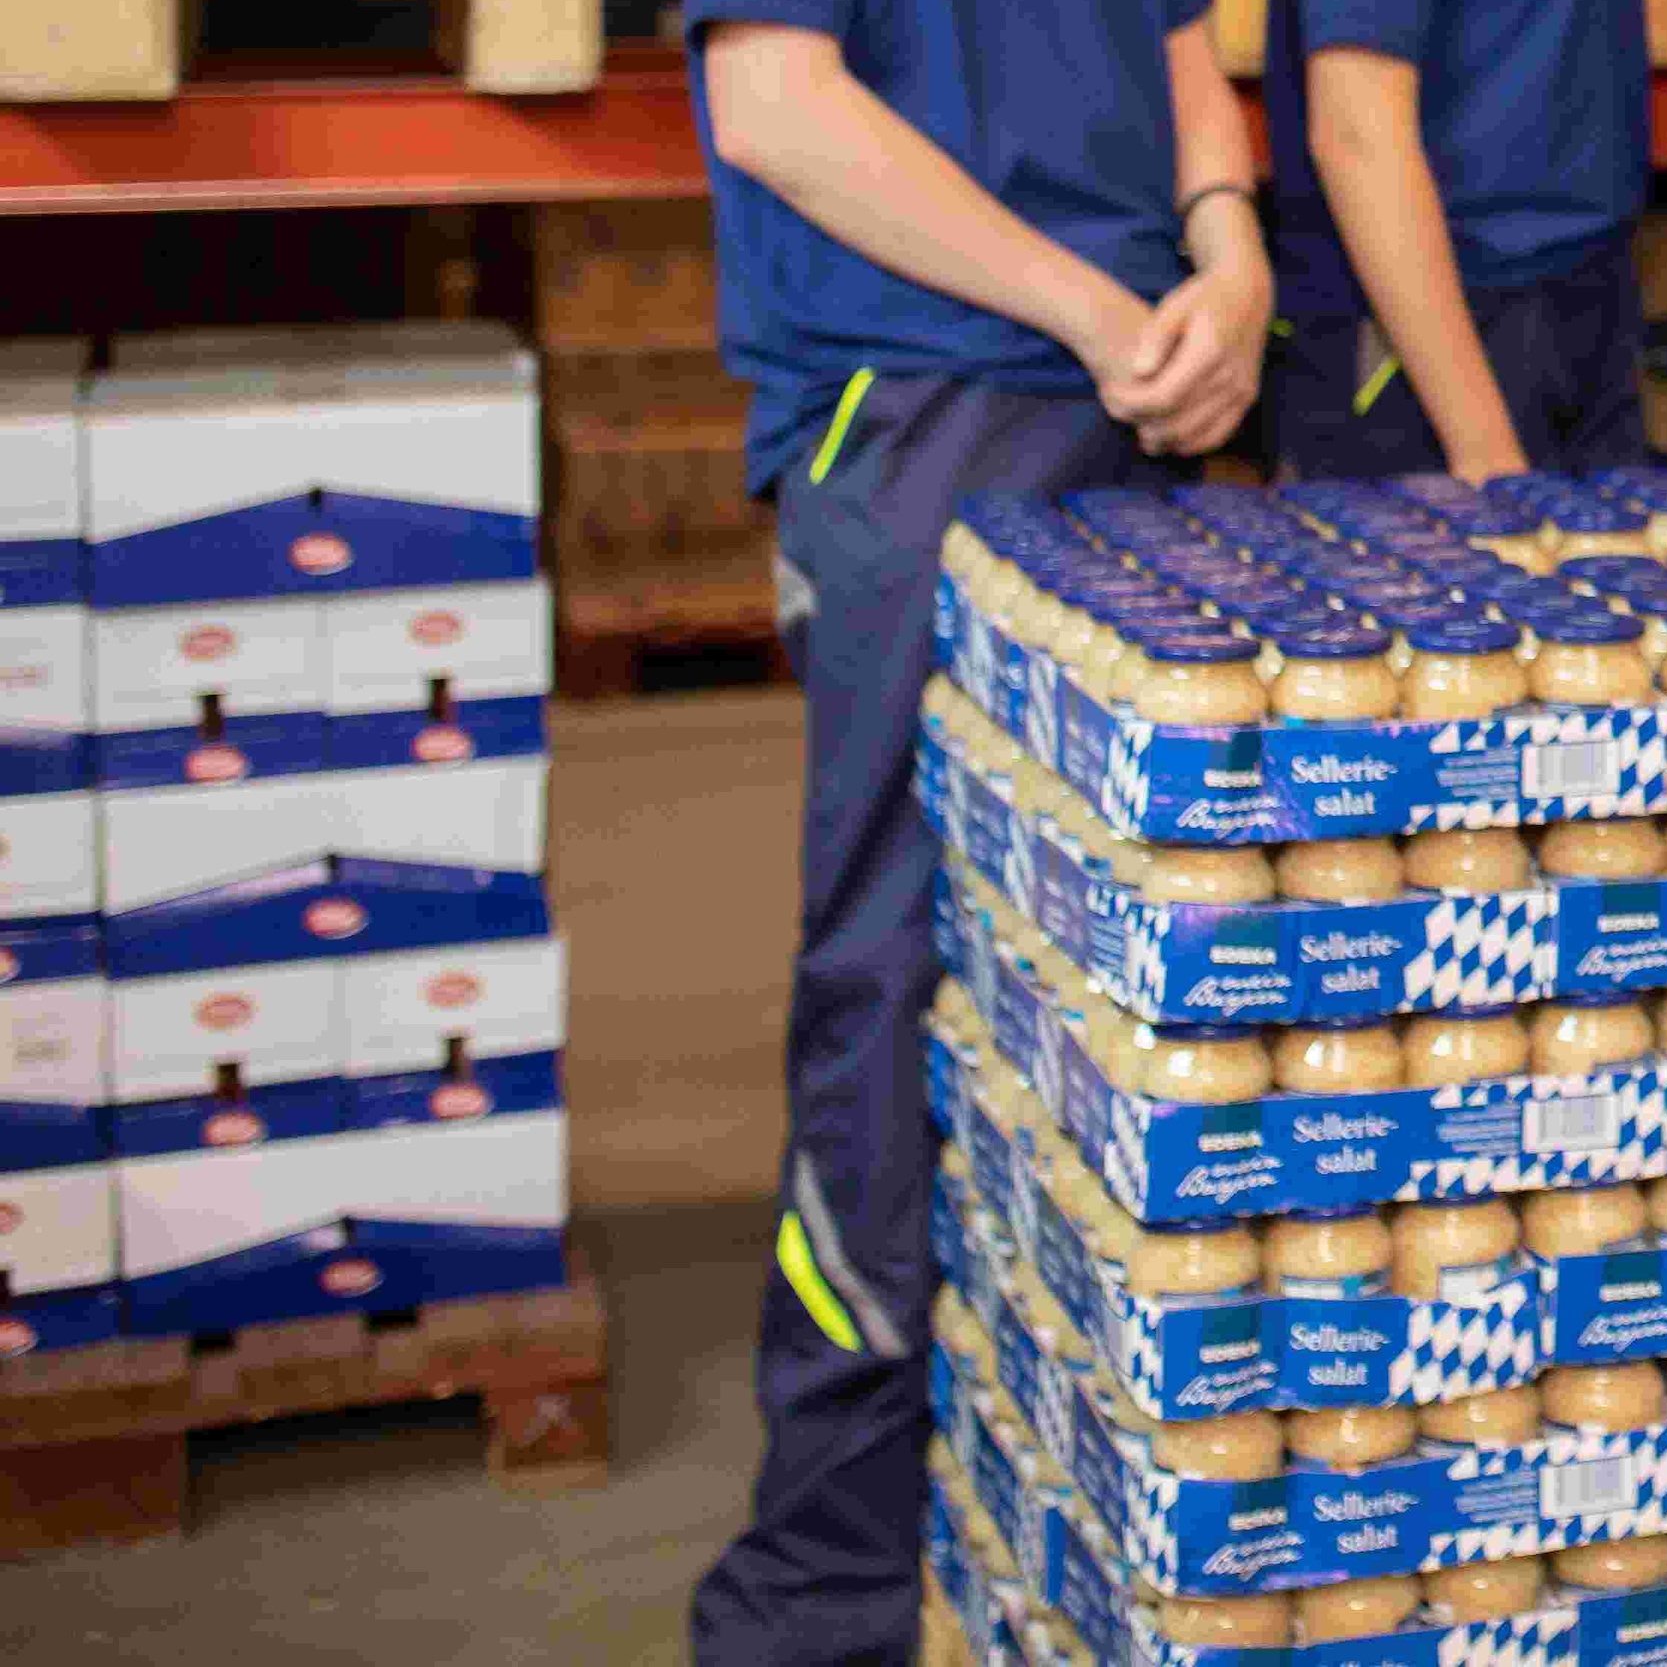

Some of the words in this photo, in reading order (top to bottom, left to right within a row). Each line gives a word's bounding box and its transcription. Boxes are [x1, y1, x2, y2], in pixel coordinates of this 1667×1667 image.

[1291, 755, 1402, 785] Sellerie-
[1301, 932, 1406, 964] Sellerie-
[1293, 1113, 1403, 1144] Sellerie-
[1290, 1325, 1393, 1353] Sellerie-
[1314, 1492, 1423, 1523] Sellerie-
